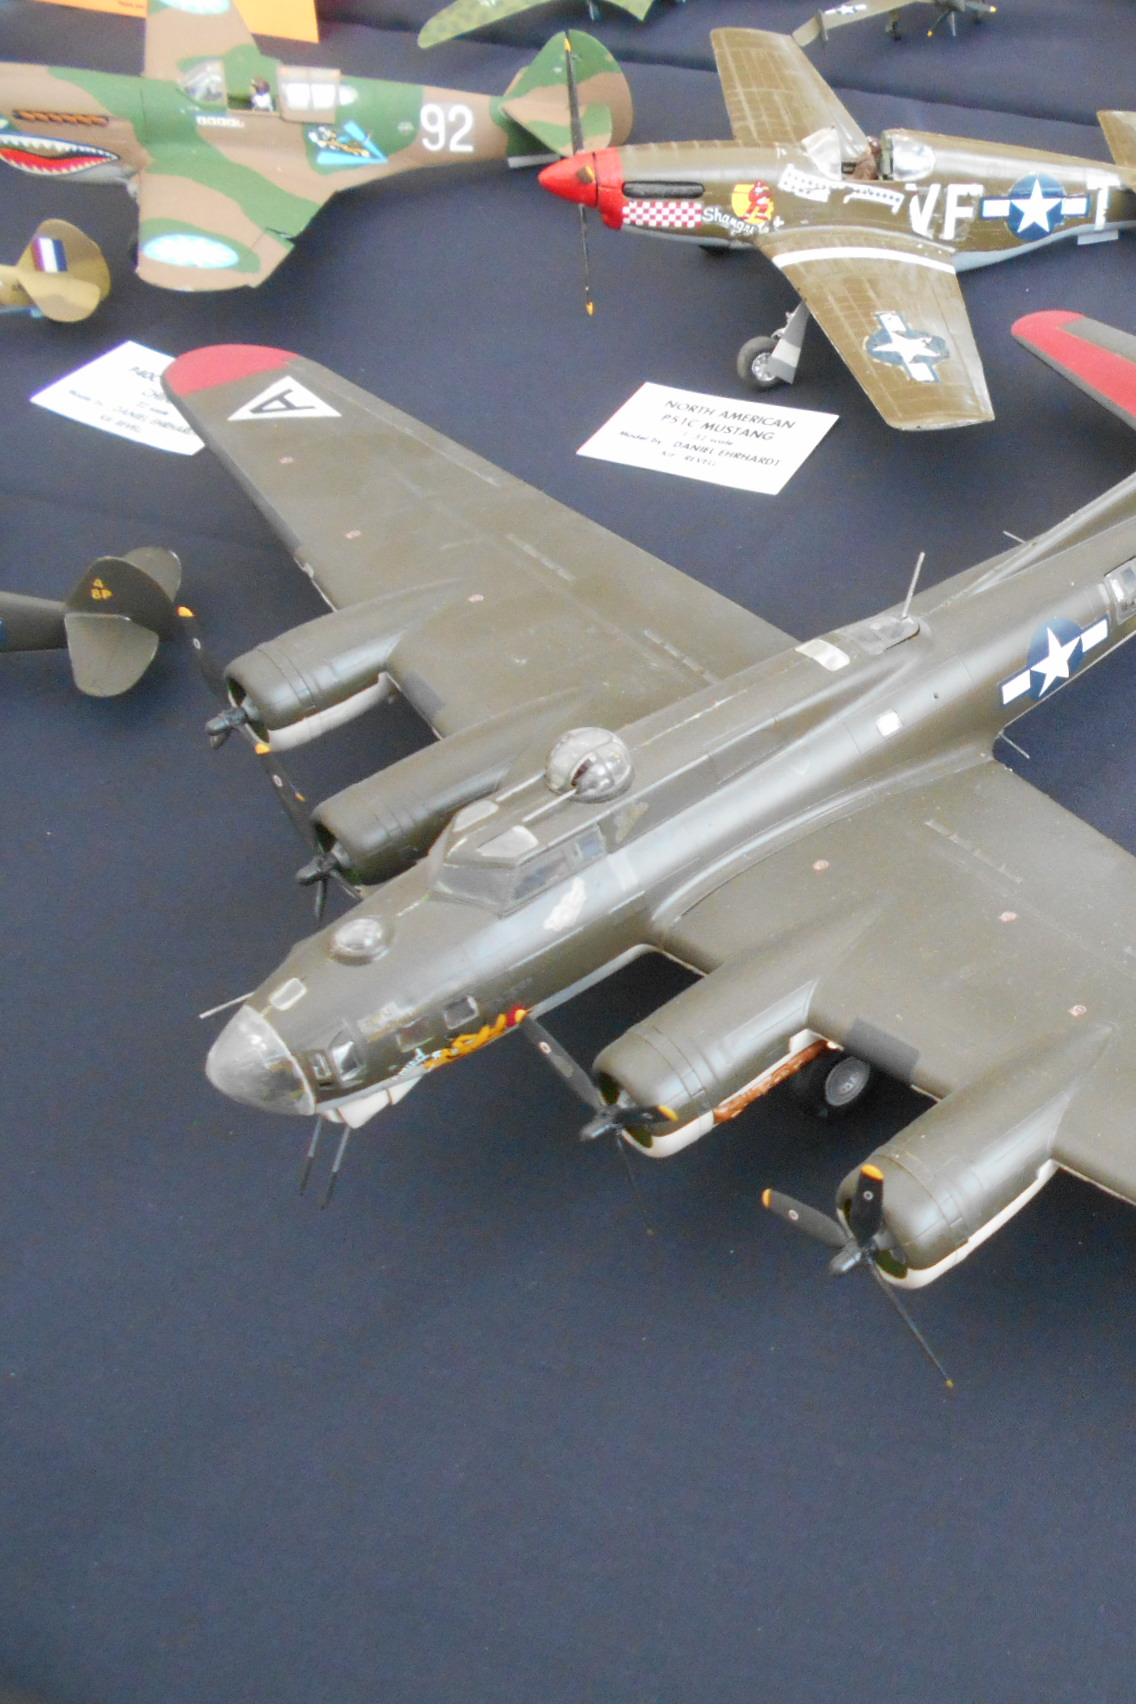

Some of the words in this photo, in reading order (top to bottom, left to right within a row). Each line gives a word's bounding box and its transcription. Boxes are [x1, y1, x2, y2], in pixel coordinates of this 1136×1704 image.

[420, 103, 473, 152] 92
[904, 183, 984, 240] VF
[1086, 175, 1124, 231] T
[249, 389, 316, 414] A
[664, 399, 716, 416] NORTH
[718, 410, 796, 430] AMERICAN
[661, 413, 701, 429] P51C
[700, 421, 775, 441] MUSTANG
[673, 441, 715, 455] DANIEL
[718, 449, 782, 467] EHRHARDT
